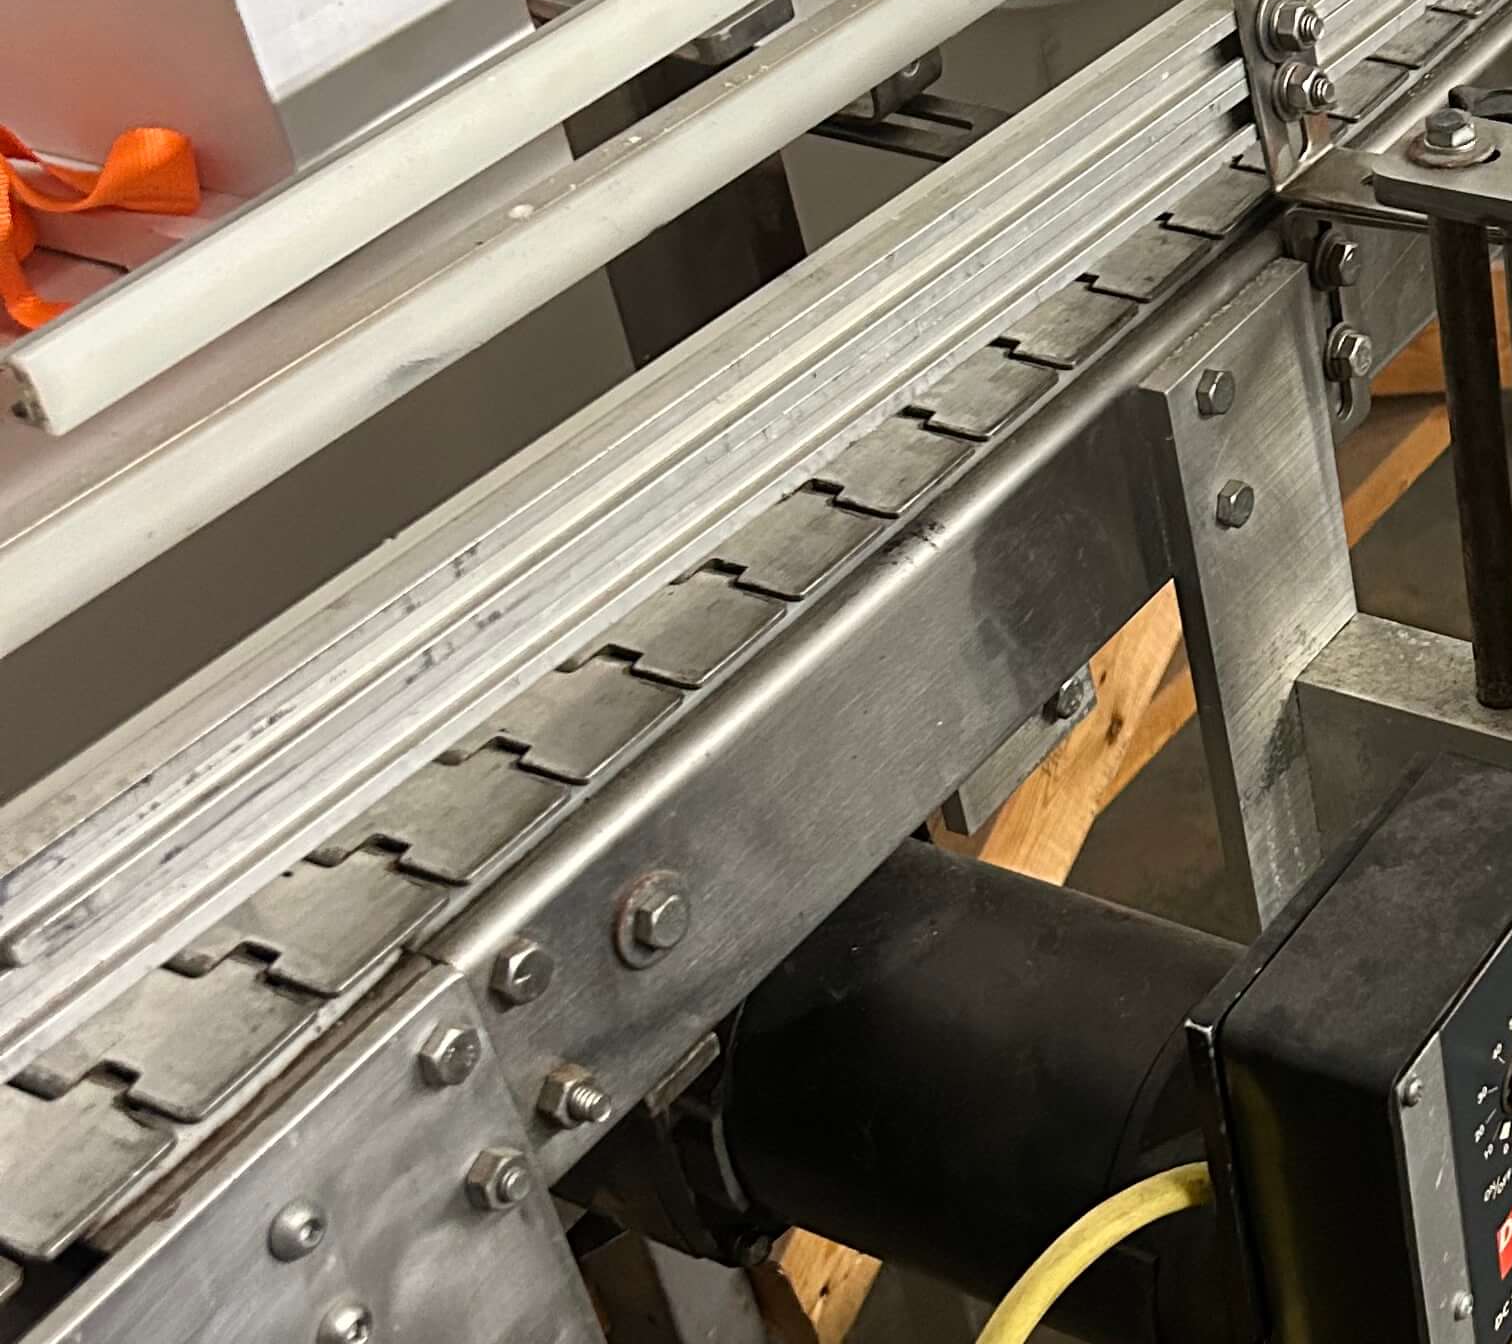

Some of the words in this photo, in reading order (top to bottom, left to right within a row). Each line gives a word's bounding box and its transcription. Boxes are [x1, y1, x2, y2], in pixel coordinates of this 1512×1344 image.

[1474, 1123, 1485, 1143] 20
[1484, 1143, 1494, 1160] 10
[1494, 1300, 1510, 1332] DC
